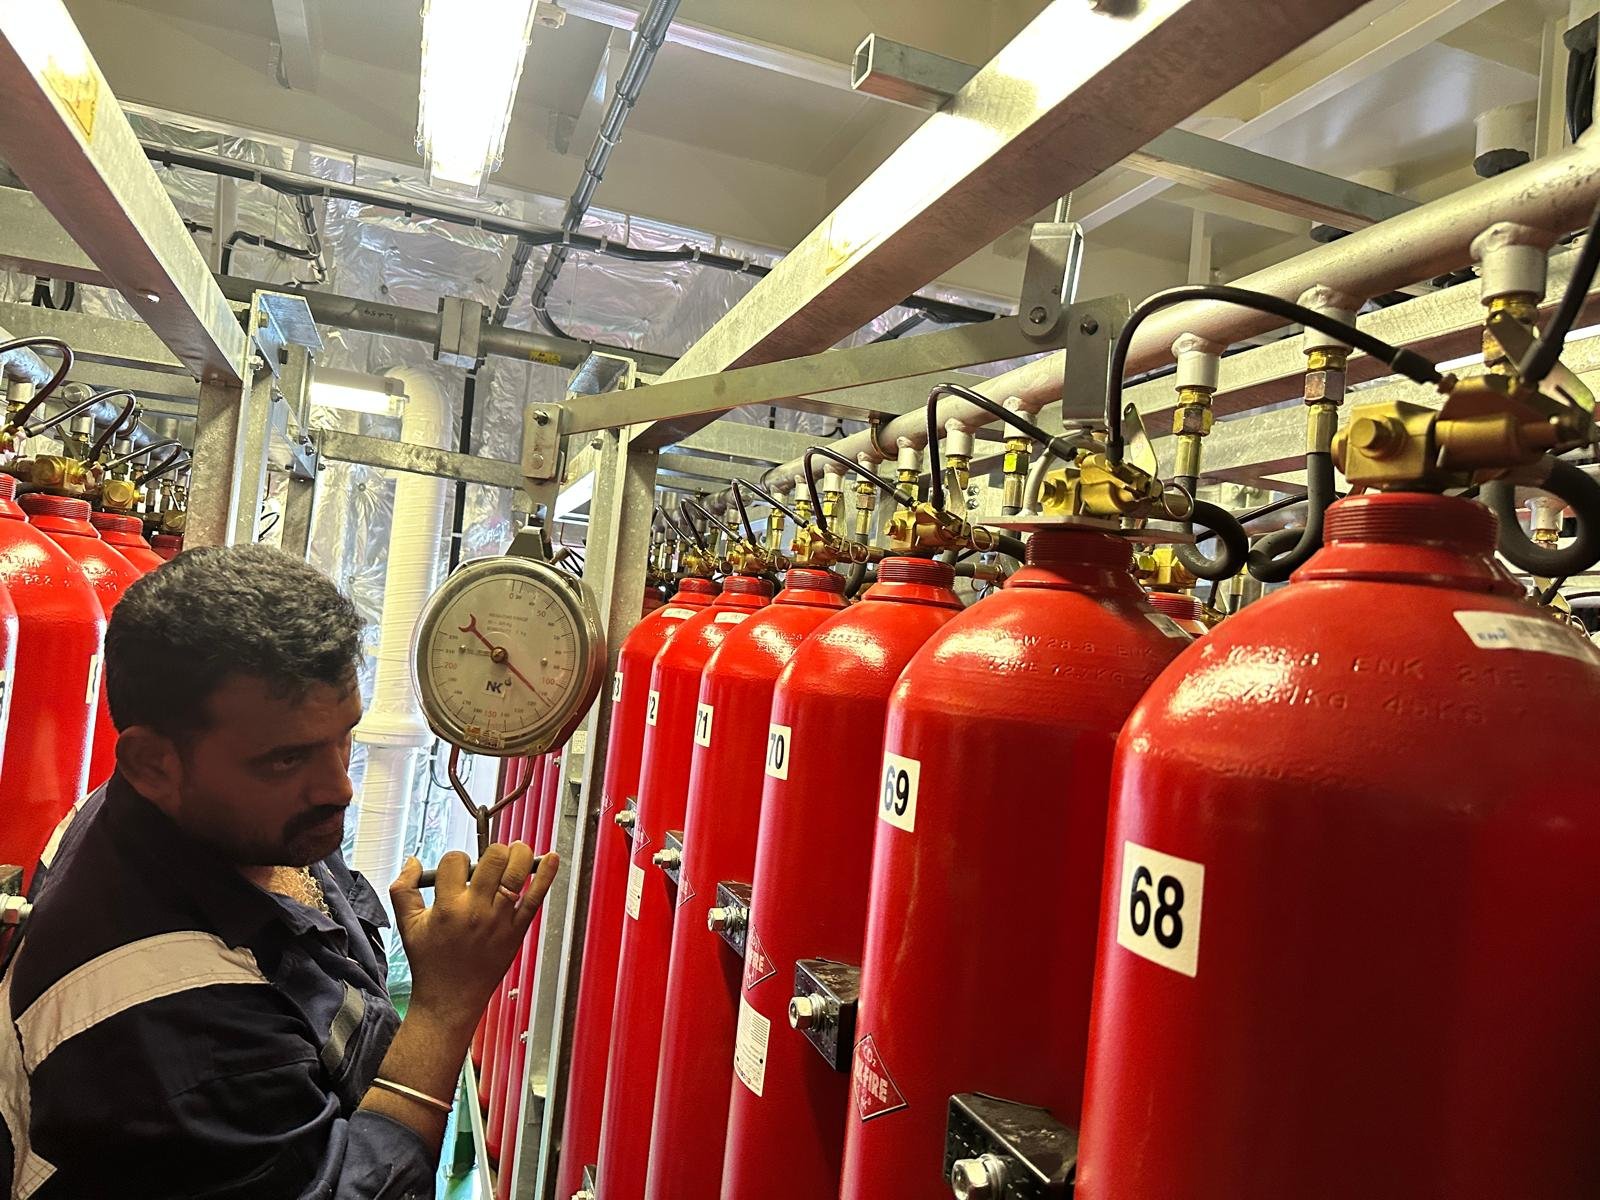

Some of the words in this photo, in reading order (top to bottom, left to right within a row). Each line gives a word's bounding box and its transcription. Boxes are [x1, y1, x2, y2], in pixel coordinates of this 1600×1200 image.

[1351, 655, 1425, 680] ENK
[696, 710, 709, 739] 71
[768, 733, 785, 770] 70
[883, 764, 910, 817] 69
[1129, 865, 1185, 950] 68
